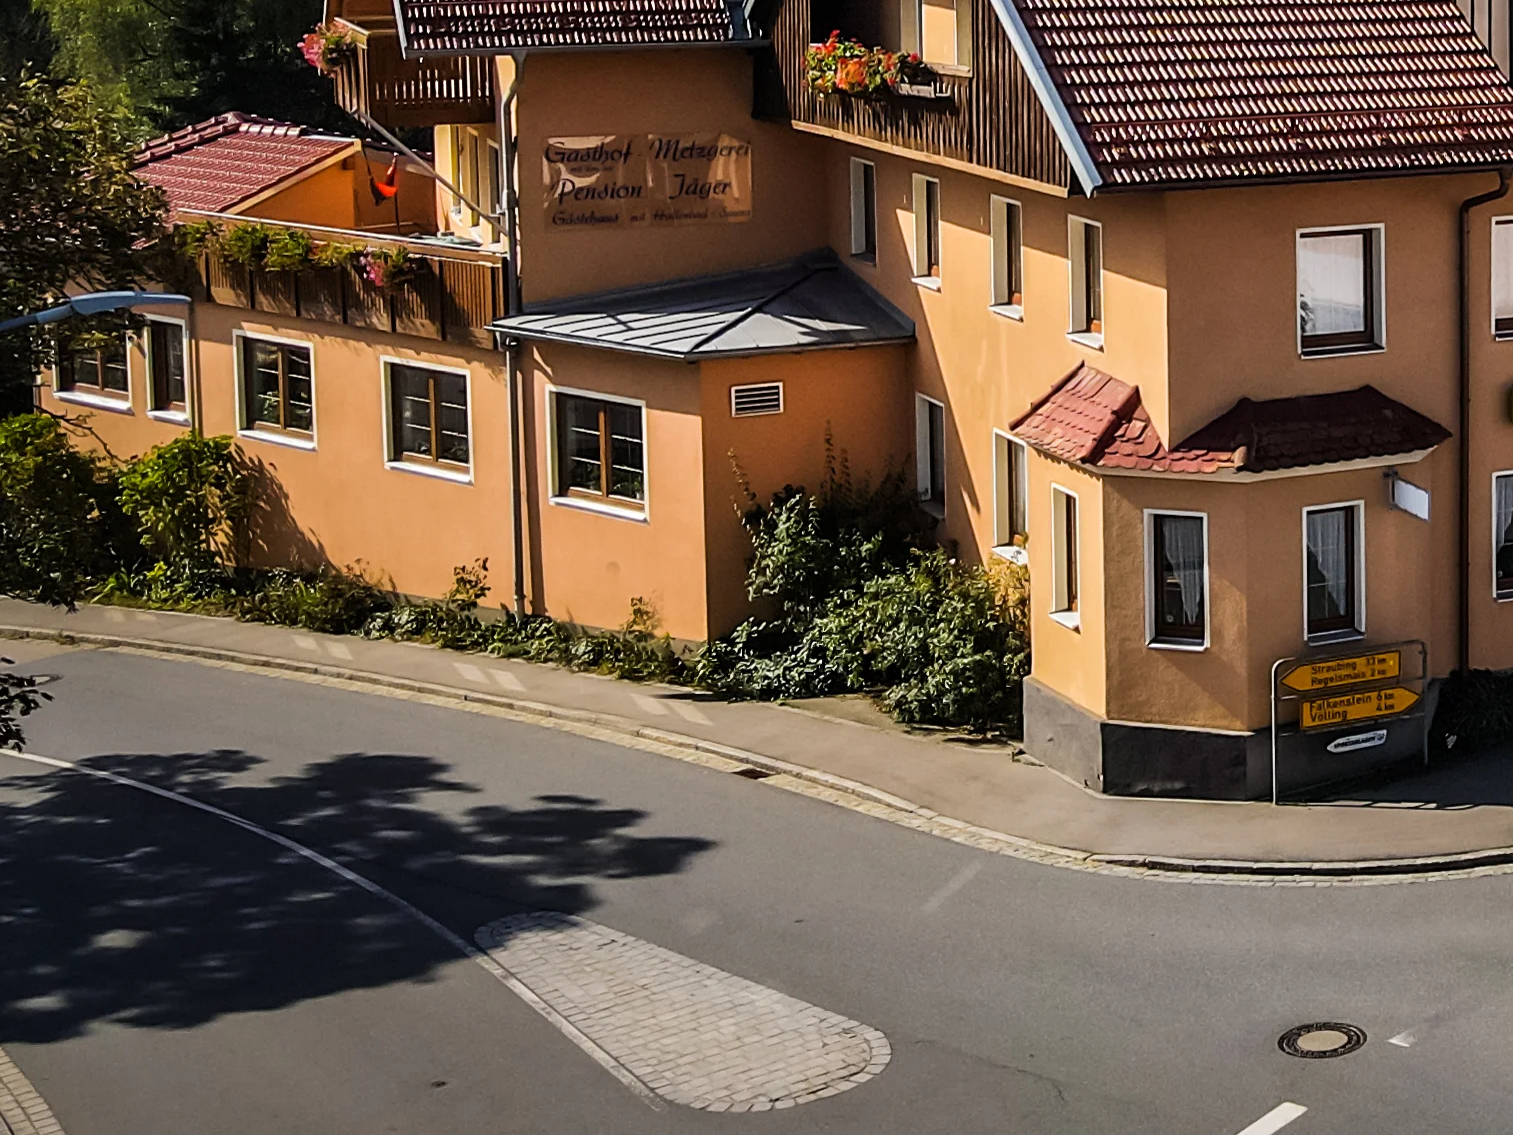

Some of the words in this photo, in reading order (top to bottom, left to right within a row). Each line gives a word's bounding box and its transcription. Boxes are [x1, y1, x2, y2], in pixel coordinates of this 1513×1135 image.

[544, 140, 633, 165] Gasthof
[648, 138, 751, 162] Metzgerei
[558, 178, 642, 206] Pension
[669, 173, 731, 200] Jäger
[1311, 662, 1357, 674] Straubing
[1311, 671, 1367, 686] Regelsmais
[1370, 669, 1375, 677] 2
[1310, 695, 1372, 710] Falkenstein
[1376, 691, 1382, 701] 6
[1384, 692, 1394, 700] km
